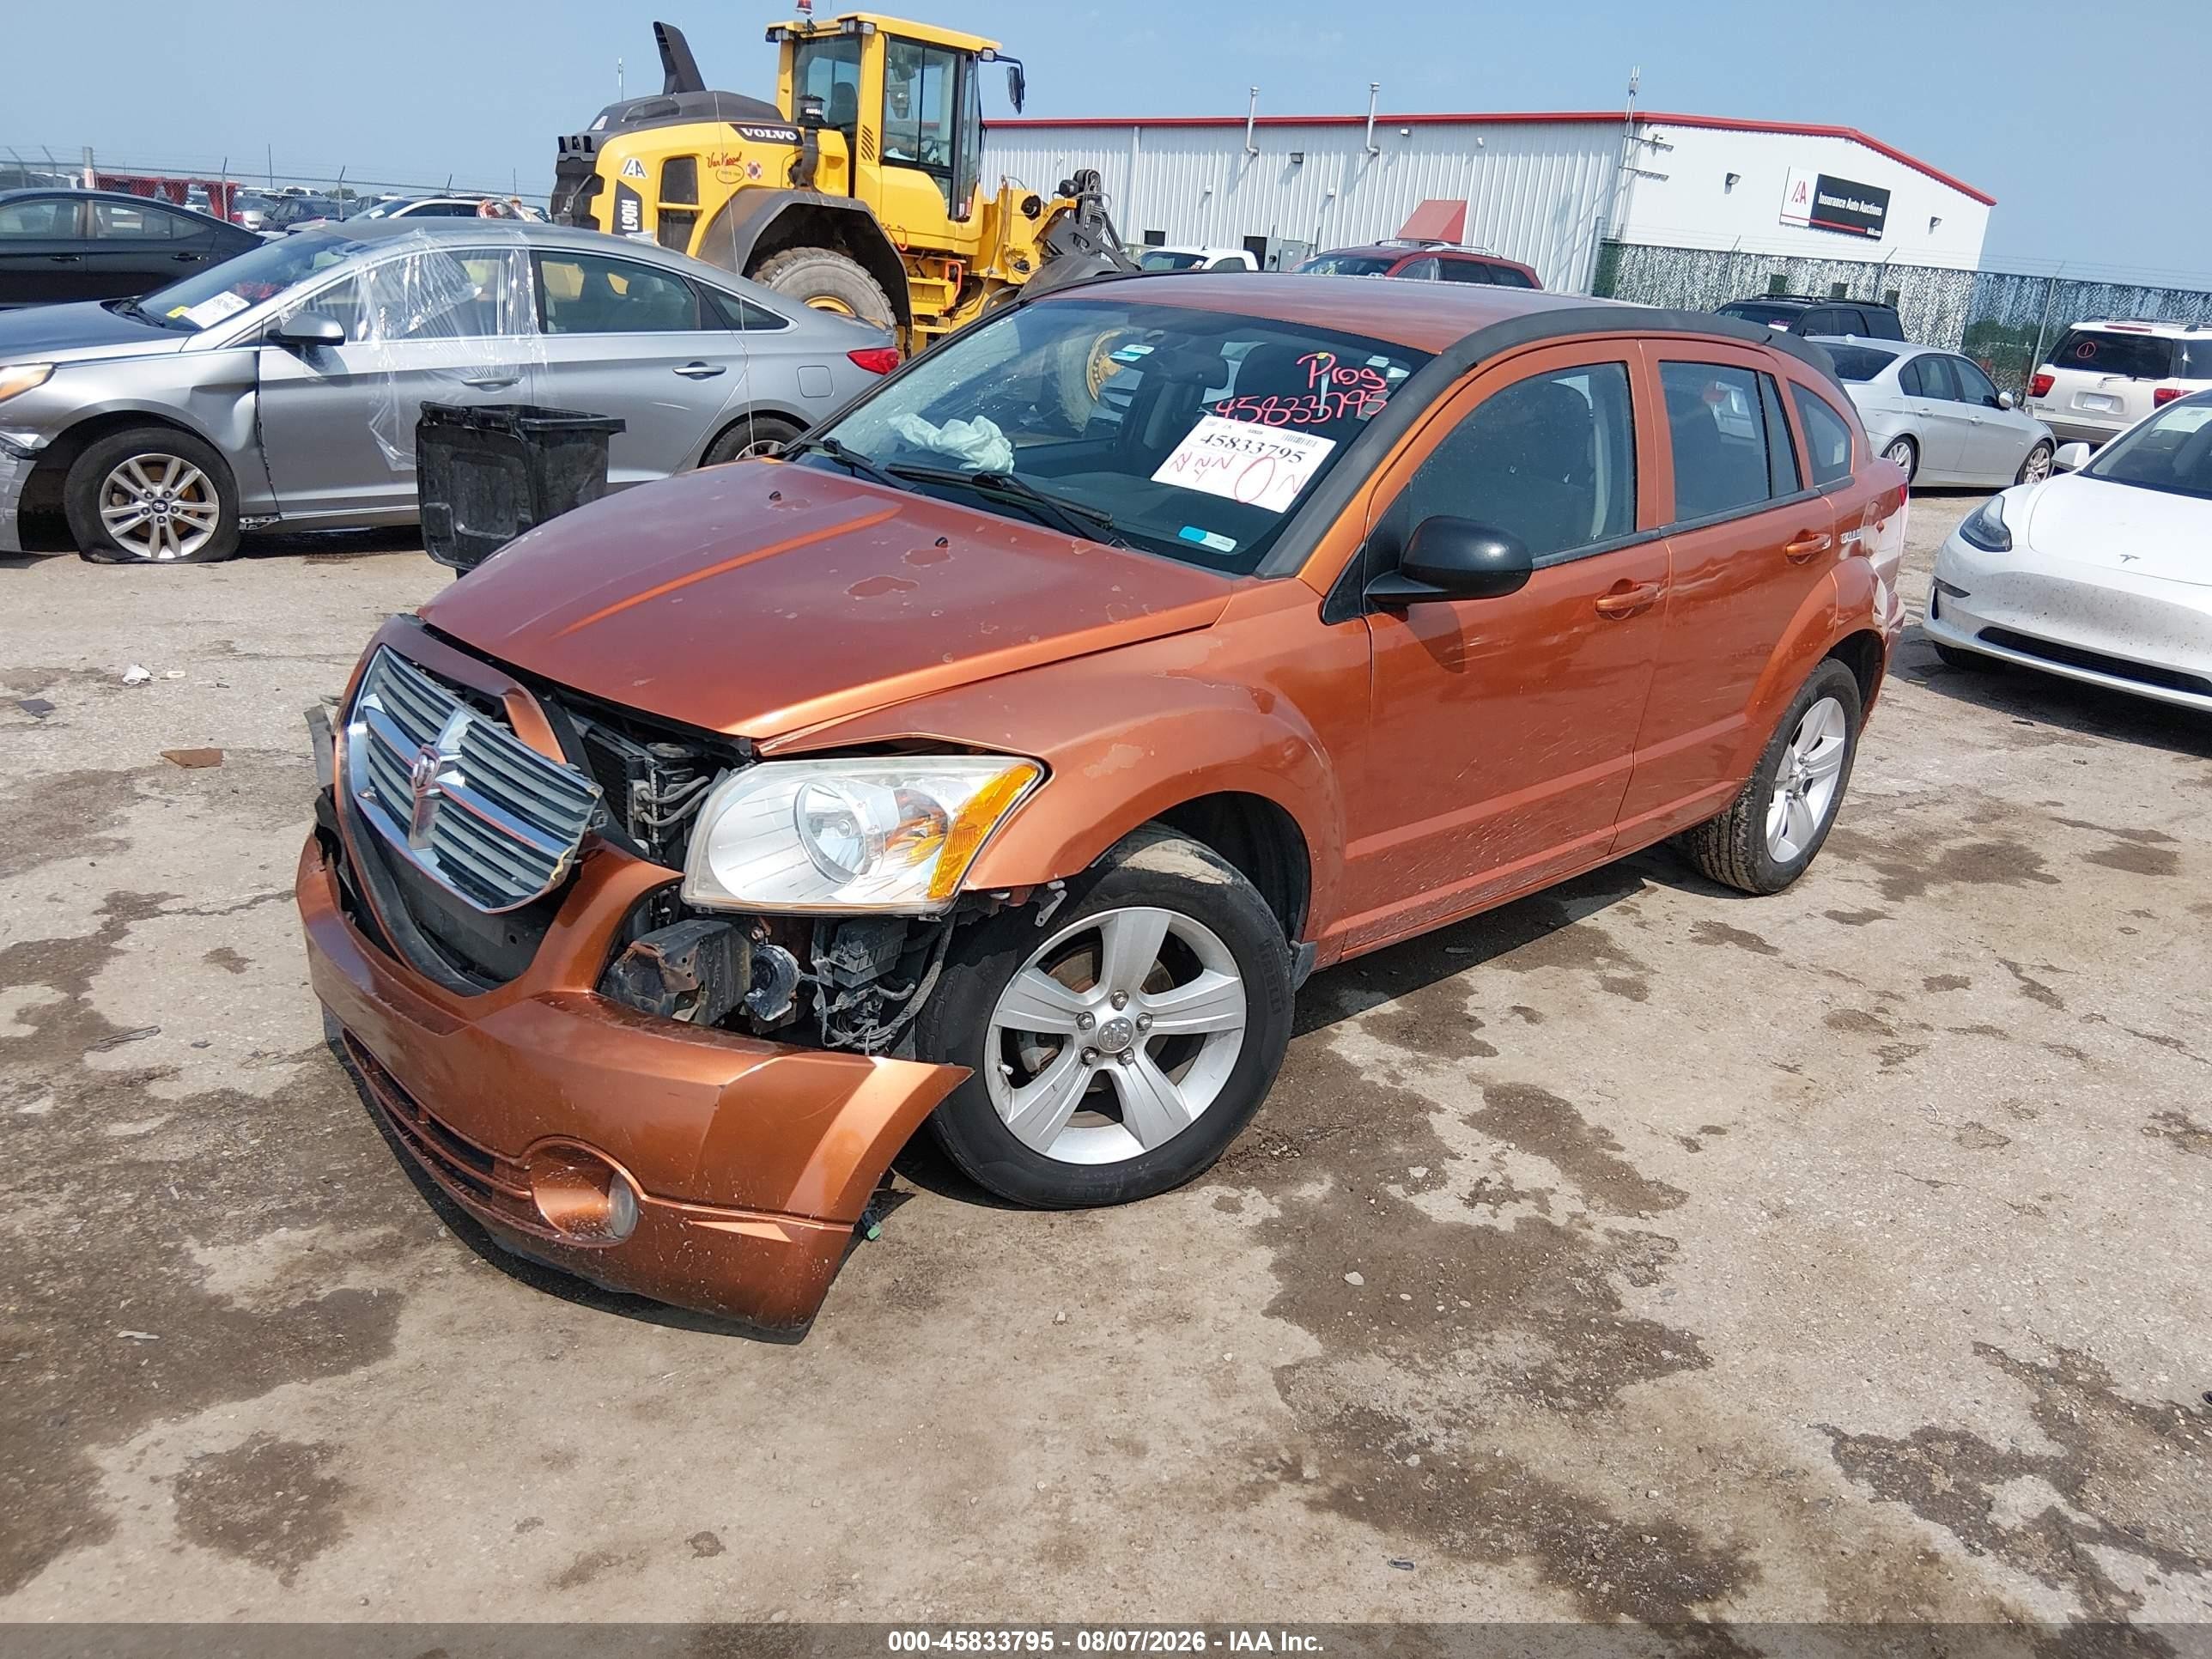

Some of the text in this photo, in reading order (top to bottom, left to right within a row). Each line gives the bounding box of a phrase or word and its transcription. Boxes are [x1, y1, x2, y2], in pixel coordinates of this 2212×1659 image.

[740, 127, 797, 141] VOLVO
[621, 199, 639, 231] L90H
[1818, 191, 1883, 216] Insurance Auto Auctions
[1215, 388, 1388, 427] 45833795
[1200, 433, 1306, 465] 45833795
